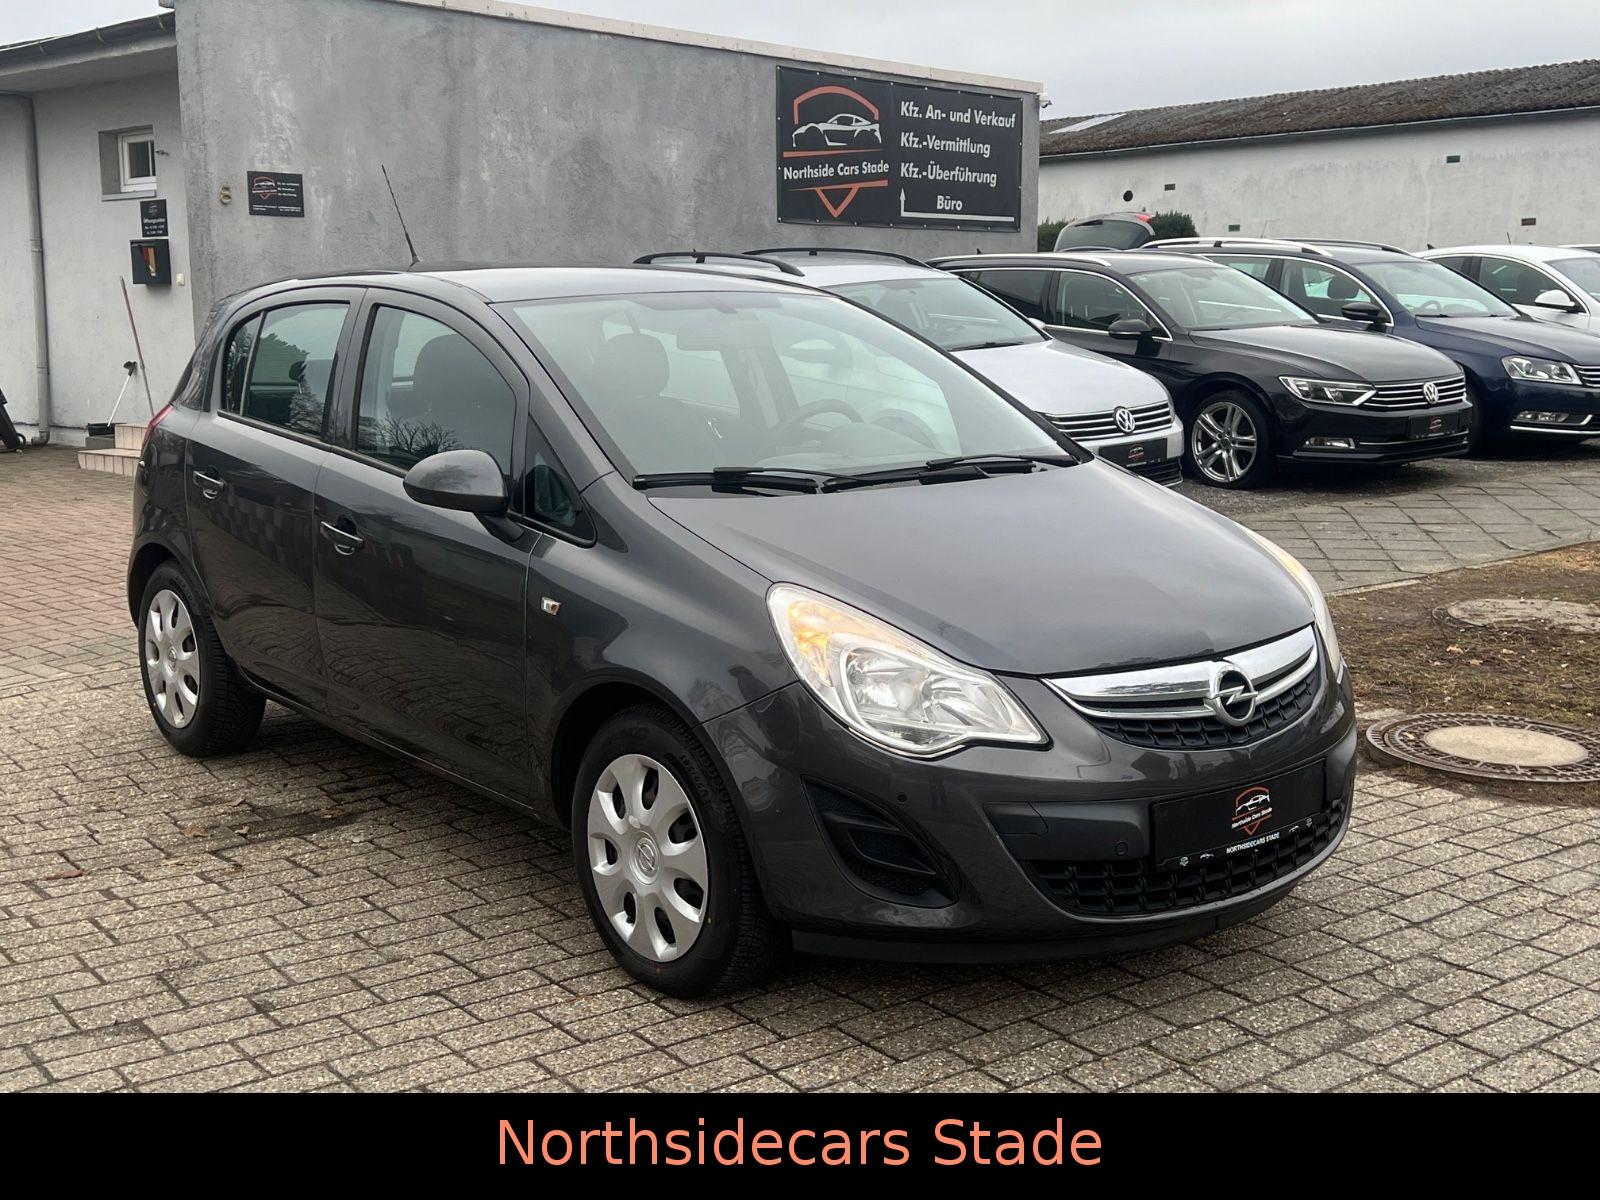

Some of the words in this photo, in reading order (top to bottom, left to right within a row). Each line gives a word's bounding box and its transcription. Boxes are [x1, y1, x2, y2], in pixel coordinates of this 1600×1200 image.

[900, 101, 922, 118] Kfz.
[925, 104, 946, 120] An-
[949, 108, 971, 123] und
[974, 109, 1016, 128] Verkauf
[900, 132, 991, 158] Kfz.-Vermittlung
[783, 164, 835, 180] Northside
[837, 163, 860, 176] Cars
[861, 160, 890, 175] Stade
[900, 161, 997, 188] Kfz.-Überführung
[936, 195, 963, 211] Büro
[1265, 832, 1280, 843] STADE
